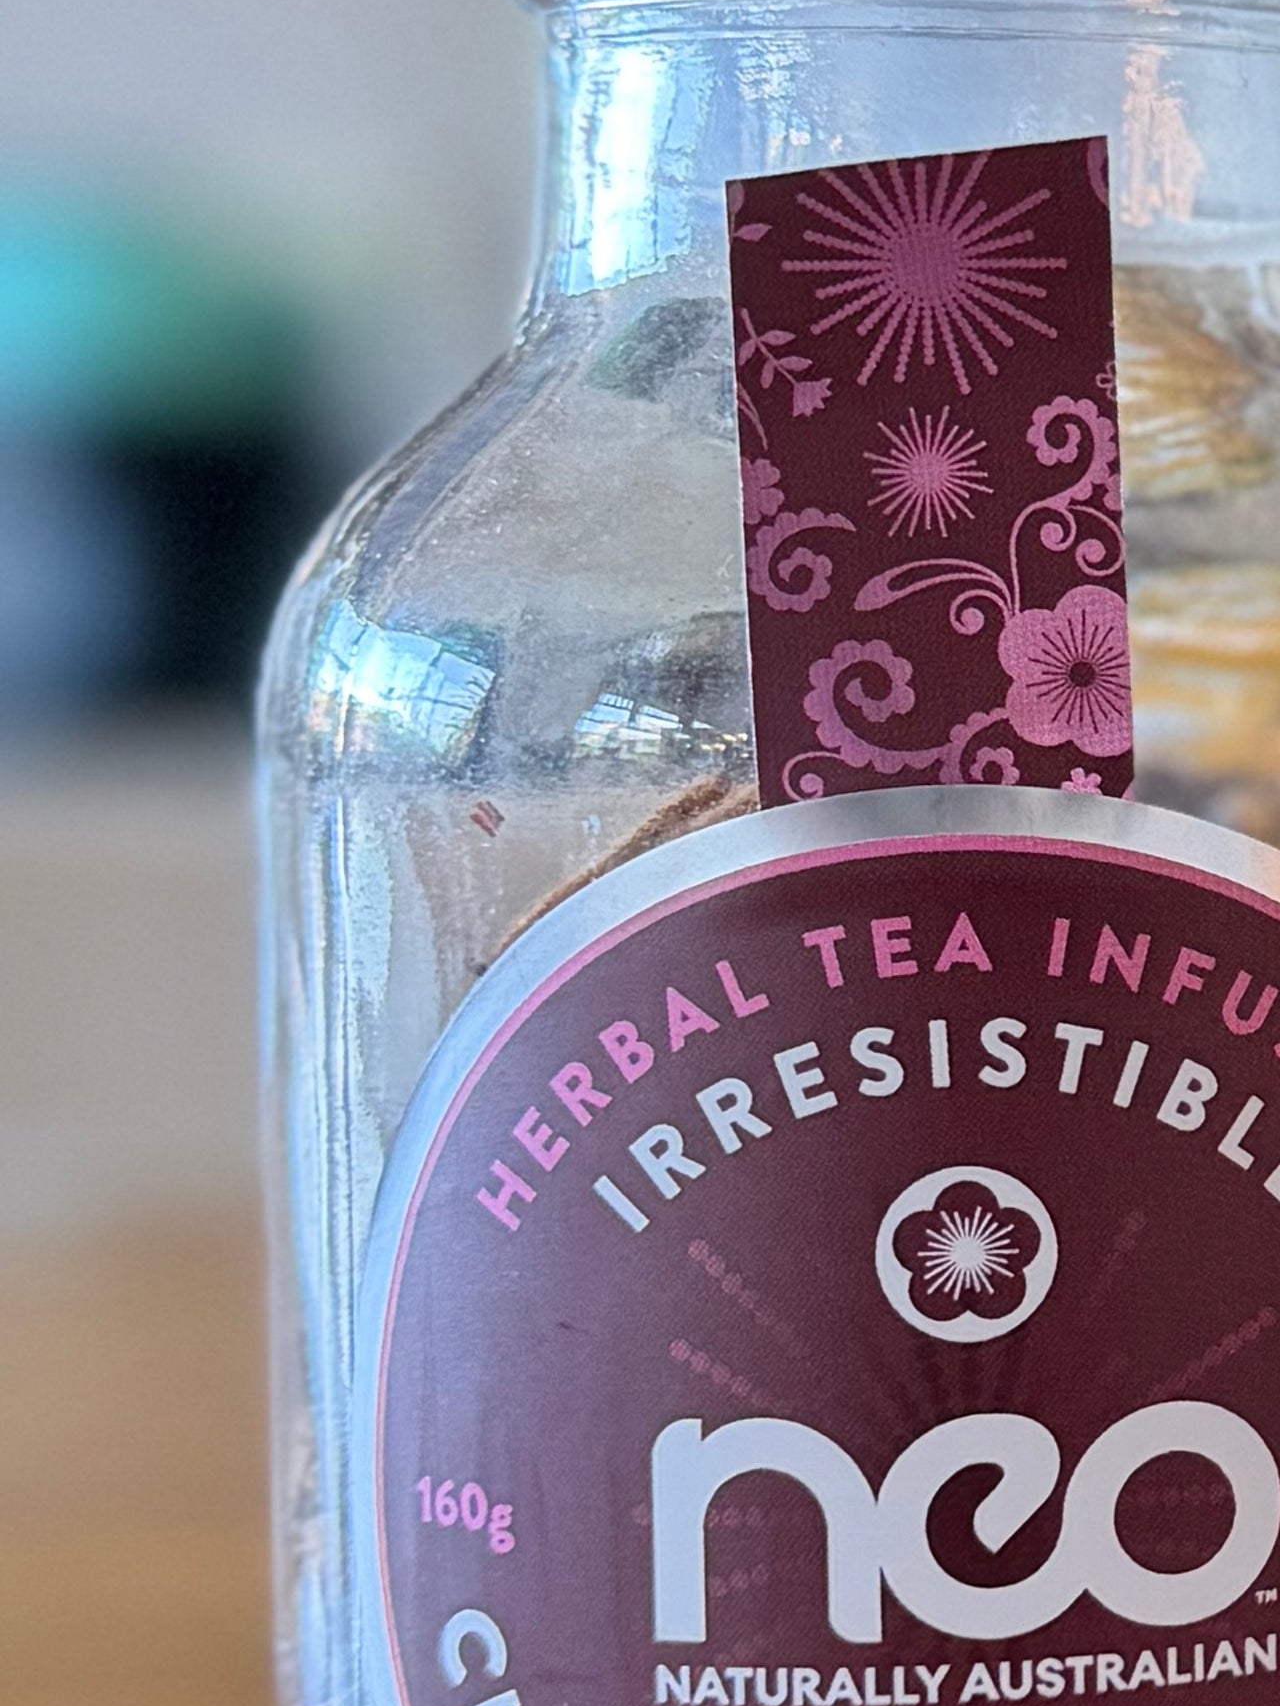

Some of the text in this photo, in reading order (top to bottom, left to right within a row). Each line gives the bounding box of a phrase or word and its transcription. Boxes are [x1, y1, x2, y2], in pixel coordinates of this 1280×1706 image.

[474, 962, 770, 1233] HERBAL
[802, 913, 992, 988] TEA
[415, 1476, 516, 1553] 160g
[959, 1634, 1278, 1704] AUSTRALIAN
